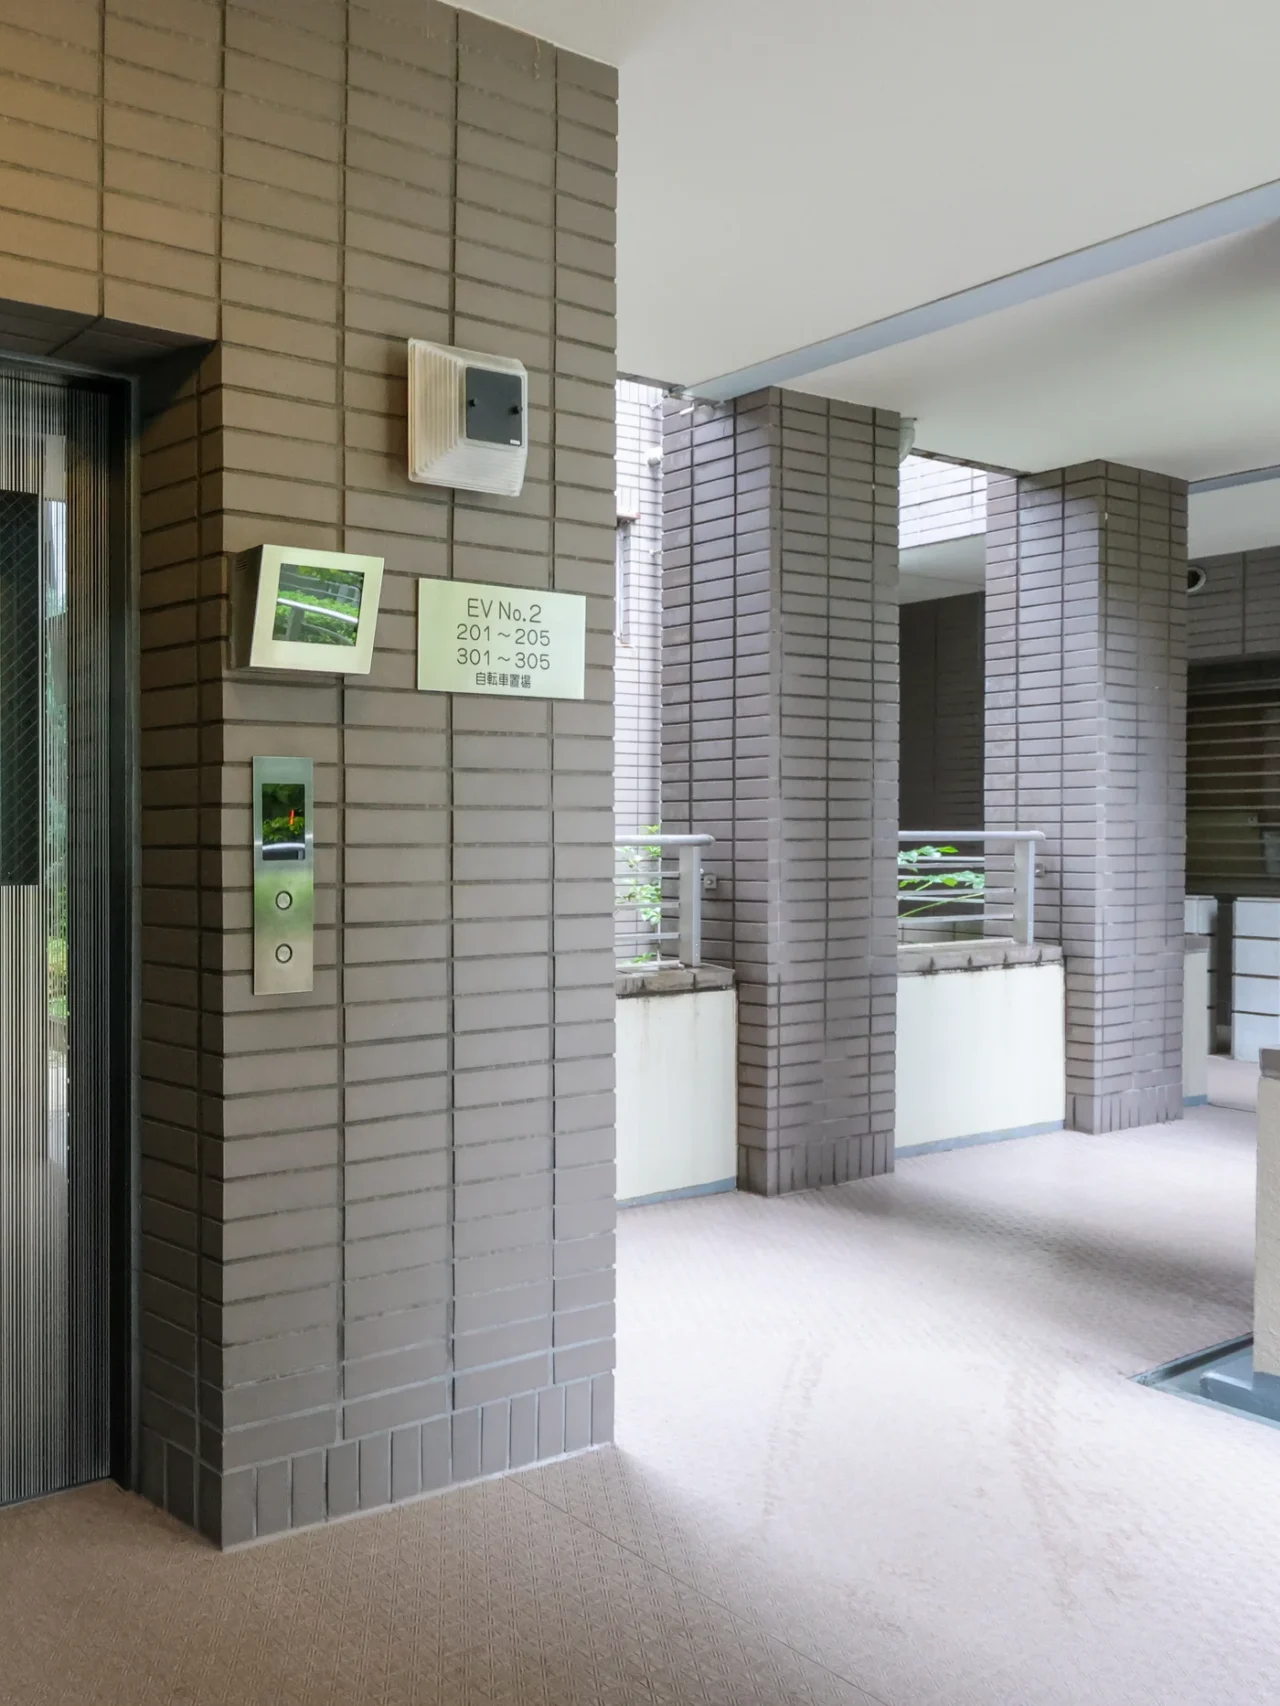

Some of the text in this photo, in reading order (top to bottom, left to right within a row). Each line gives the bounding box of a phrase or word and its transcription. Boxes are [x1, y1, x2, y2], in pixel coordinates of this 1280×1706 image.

[467, 597, 542, 623] EV No.2
[475, 671, 532, 689] 自転車置場
